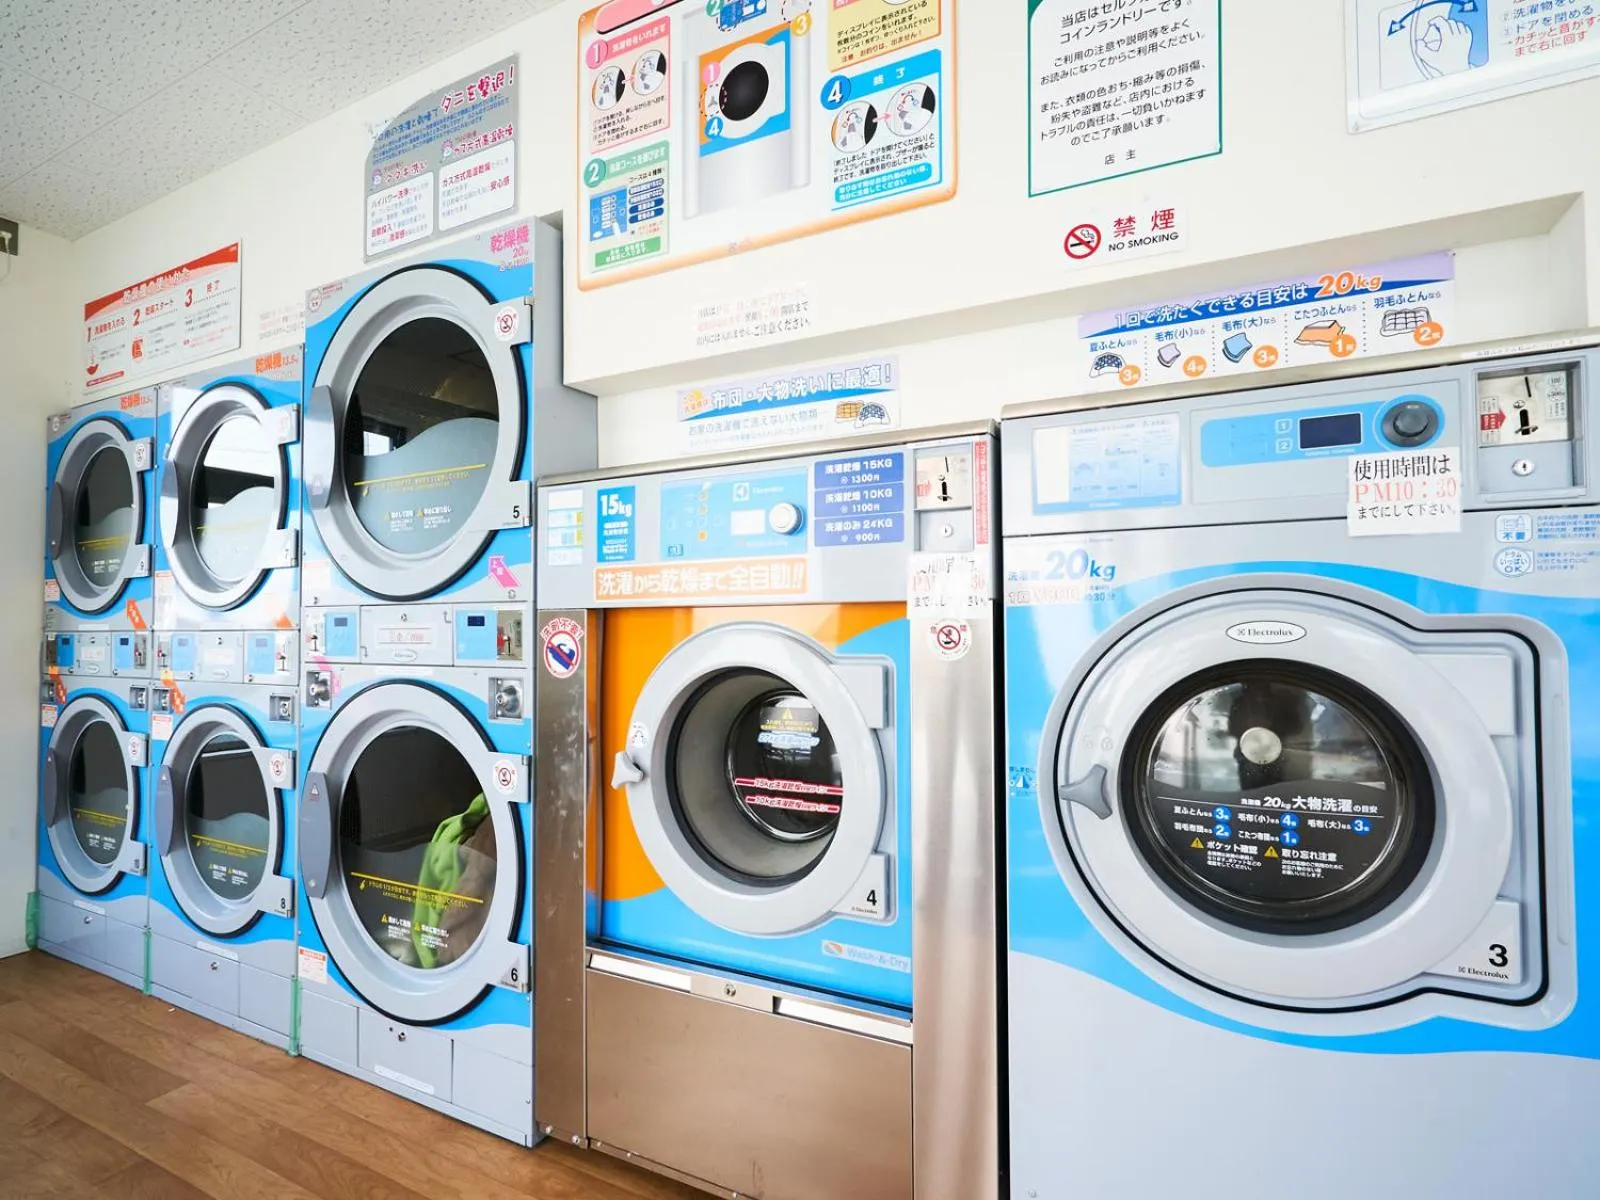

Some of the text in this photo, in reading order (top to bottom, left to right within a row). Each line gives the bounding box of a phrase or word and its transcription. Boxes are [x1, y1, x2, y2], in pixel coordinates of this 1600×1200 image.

[796, 14, 806, 34] 3
[1054, 19, 1191, 67] ご利用の注意や説明等をよく
[592, 44, 600, 64] 1
[1040, 32, 1206, 86] お読みになってからご利用ください。
[706, 65, 715, 83] 1
[827, 81, 843, 104] 4
[1040, 60, 1206, 113] また、衣類の色おち・縮み等の損傷、
[1051, 77, 1195, 125] 紛失や盗難など、店内における
[1040, 88, 1206, 141] トラブルの責任は、一切負いかねます
[707, 120, 721, 136] 4
[1070, 114, 1170, 146] のでご了承願います。
[588, 163, 600, 184] 2
[1108, 231, 1179, 252] NO SMOKING
[184, 288, 193, 308] 3
[1114, 271, 1383, 329] 1回で洗たくできる目安は 20kg
[132, 308, 141, 328] 2
[711, 363, 891, 410] 布団・大物洗いに最適!
[863, 459, 893, 470] 15KG
[1354, 454, 1452, 482] 使用時間は
[863, 488, 893, 501] 10KG
[512, 505, 521, 520] 5
[600, 493, 633, 518] 15kg
[1358, 503, 1457, 520] までにして下さい。
[862, 518, 893, 530] 24KG
[1504, 565, 1522, 574] OK
[1248, 628, 1293, 636] Electrolux
[1263, 796, 1291, 810] 20kg
[1291, 795, 1379, 814] 大物洗濯の目安
[1207, 841, 1258, 855] ポケット確認
[1281, 848, 1338, 862] 取り忘れ注意
[866, 889, 877, 906] 4
[1488, 943, 1509, 968] 3
[510, 967, 519, 983] 6
[1467, 967, 1510, 980] Electrolux
